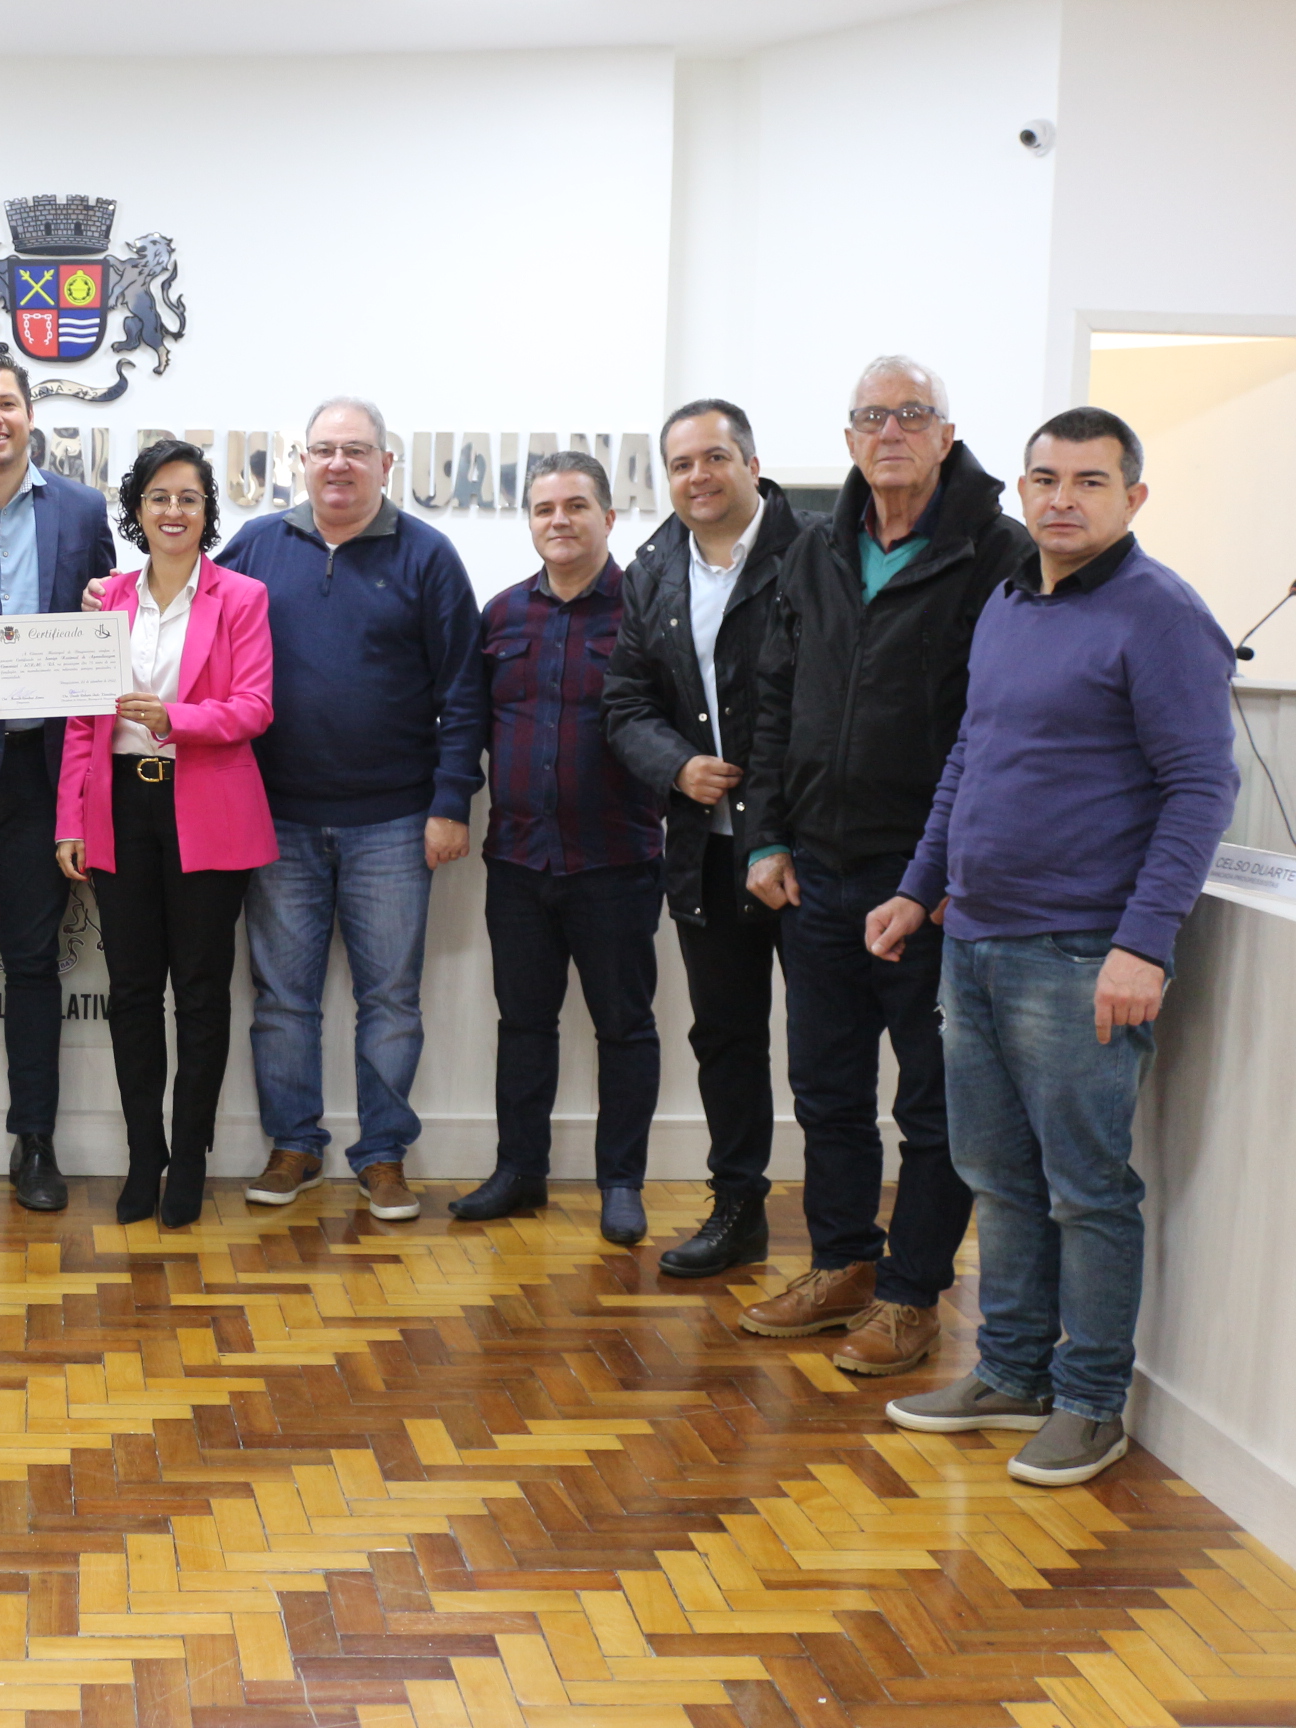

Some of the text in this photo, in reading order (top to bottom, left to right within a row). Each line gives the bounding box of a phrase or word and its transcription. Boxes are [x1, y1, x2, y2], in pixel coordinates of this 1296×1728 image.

[28, 626, 84, 640] Certificado
[1215, 857, 1296, 882] CELSO DUARTE
